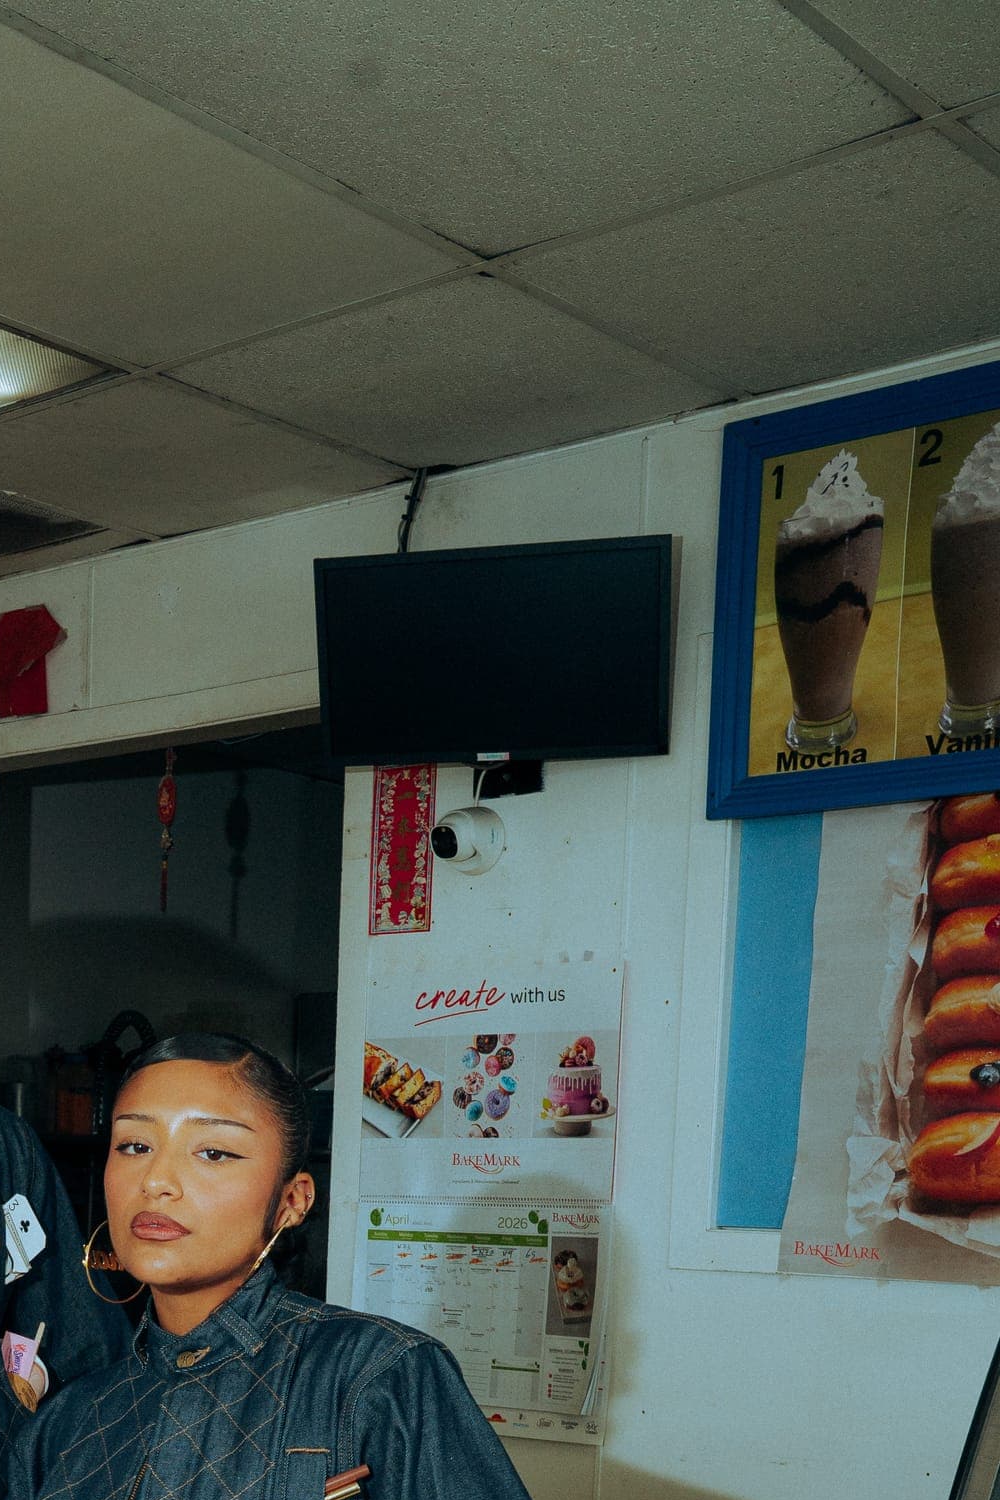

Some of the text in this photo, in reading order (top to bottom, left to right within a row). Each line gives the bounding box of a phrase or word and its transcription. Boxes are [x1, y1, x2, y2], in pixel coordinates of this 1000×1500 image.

[918, 429, 944, 467] 2
[772, 465, 784, 500] 1
[776, 746, 868, 773] Mocha
[415, 979, 566, 1010] create with us
[8, 1198, 20, 1211] 3
[385, 1213, 409, 1227] April
[497, 1216, 529, 1230] 2026
